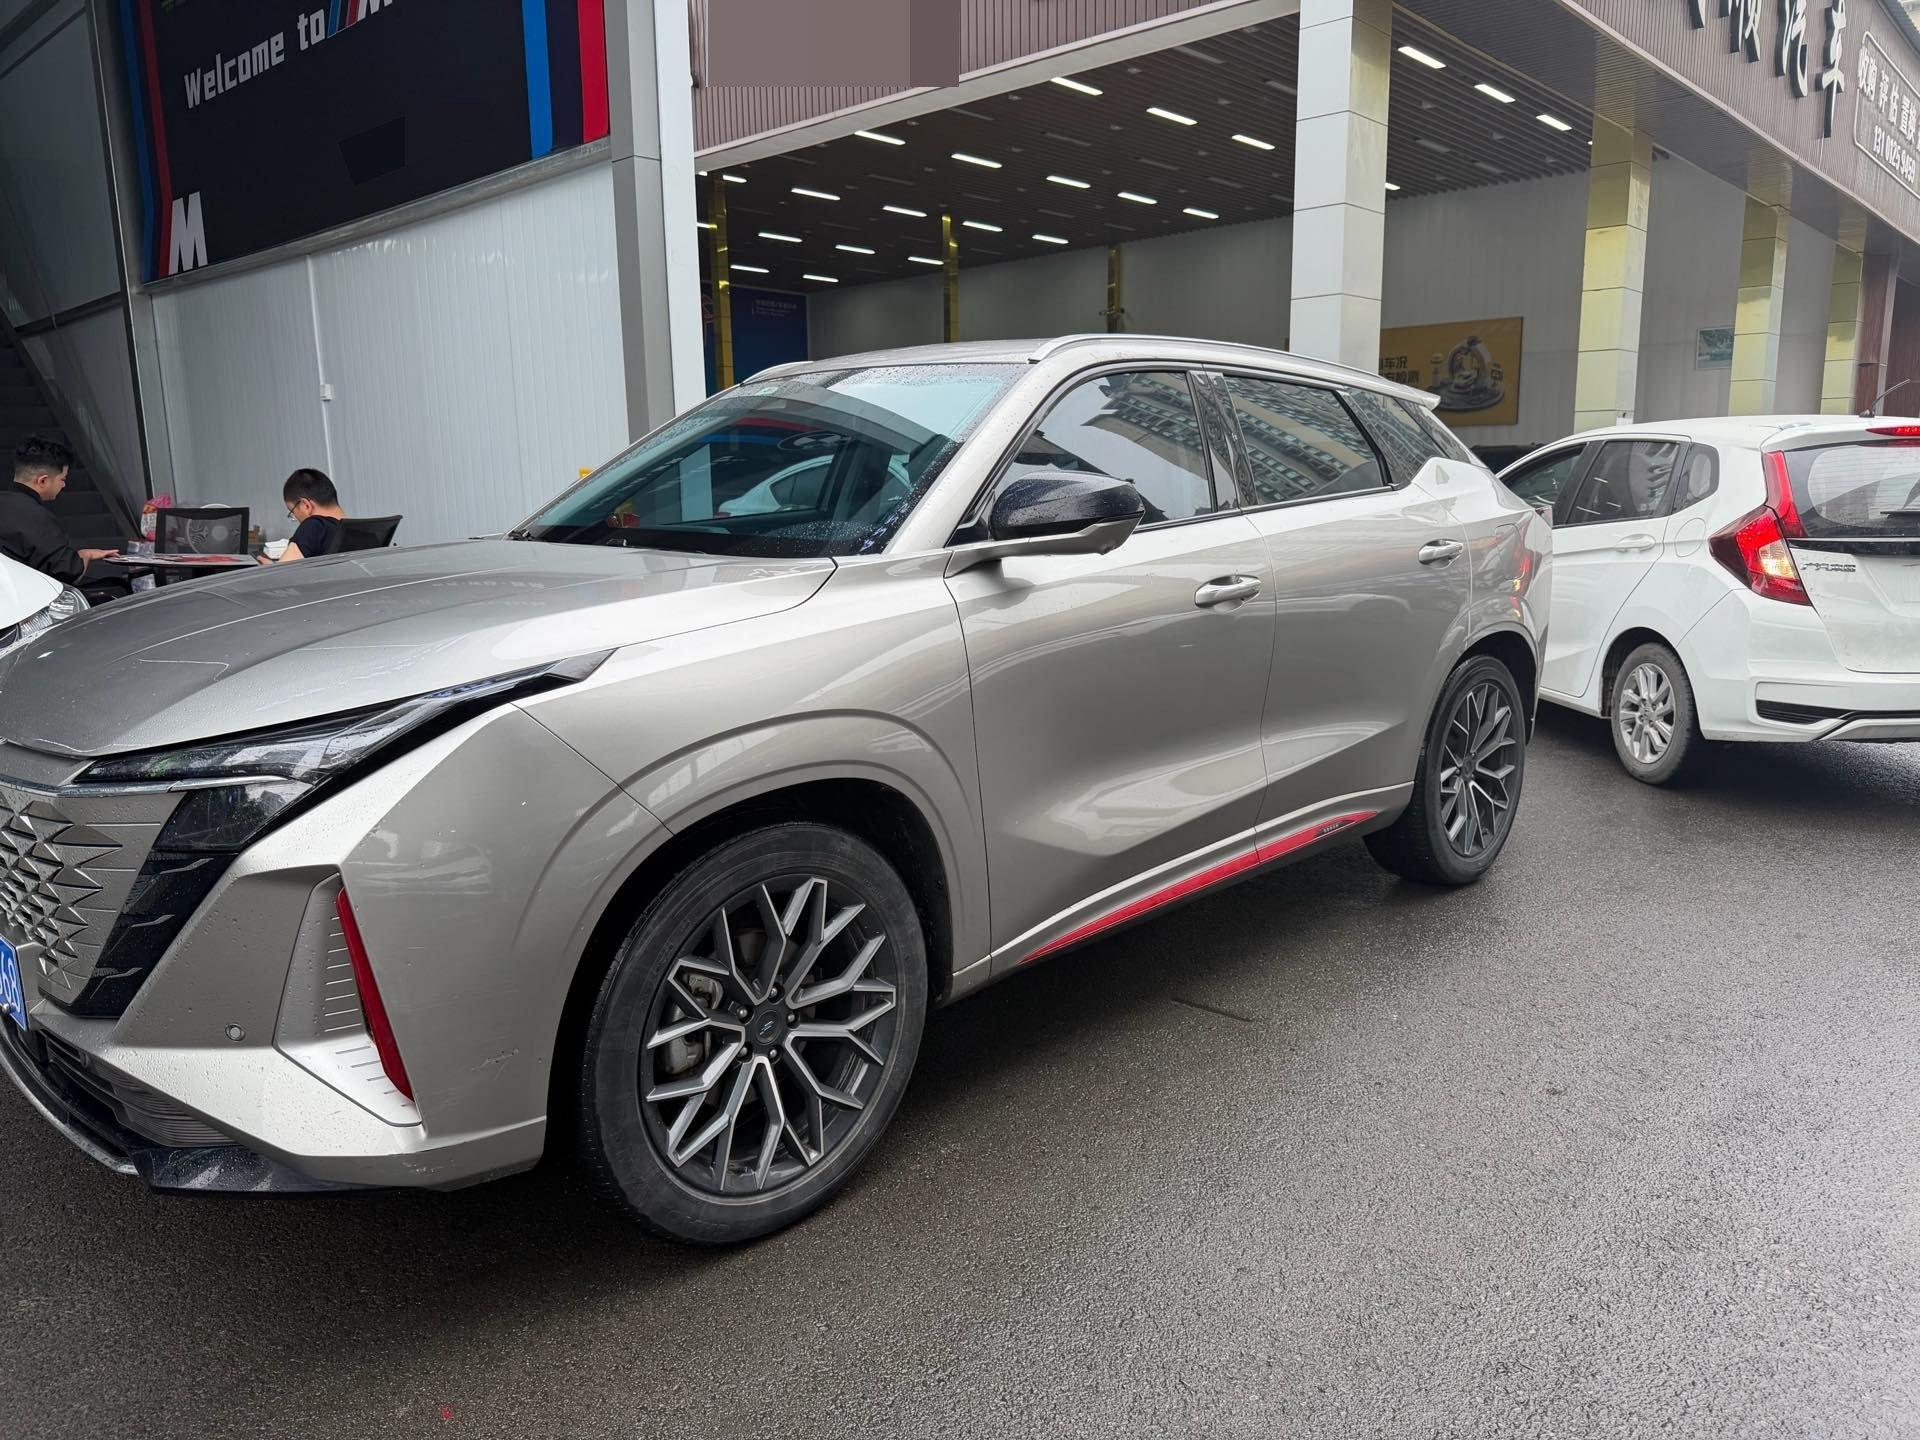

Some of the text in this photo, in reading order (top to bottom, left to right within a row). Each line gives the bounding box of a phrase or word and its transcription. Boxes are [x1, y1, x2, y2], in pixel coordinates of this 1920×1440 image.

[184, 8, 326, 109] Welcome to
[168, 191, 208, 276] M
[0, 951, 21, 1014] 68
